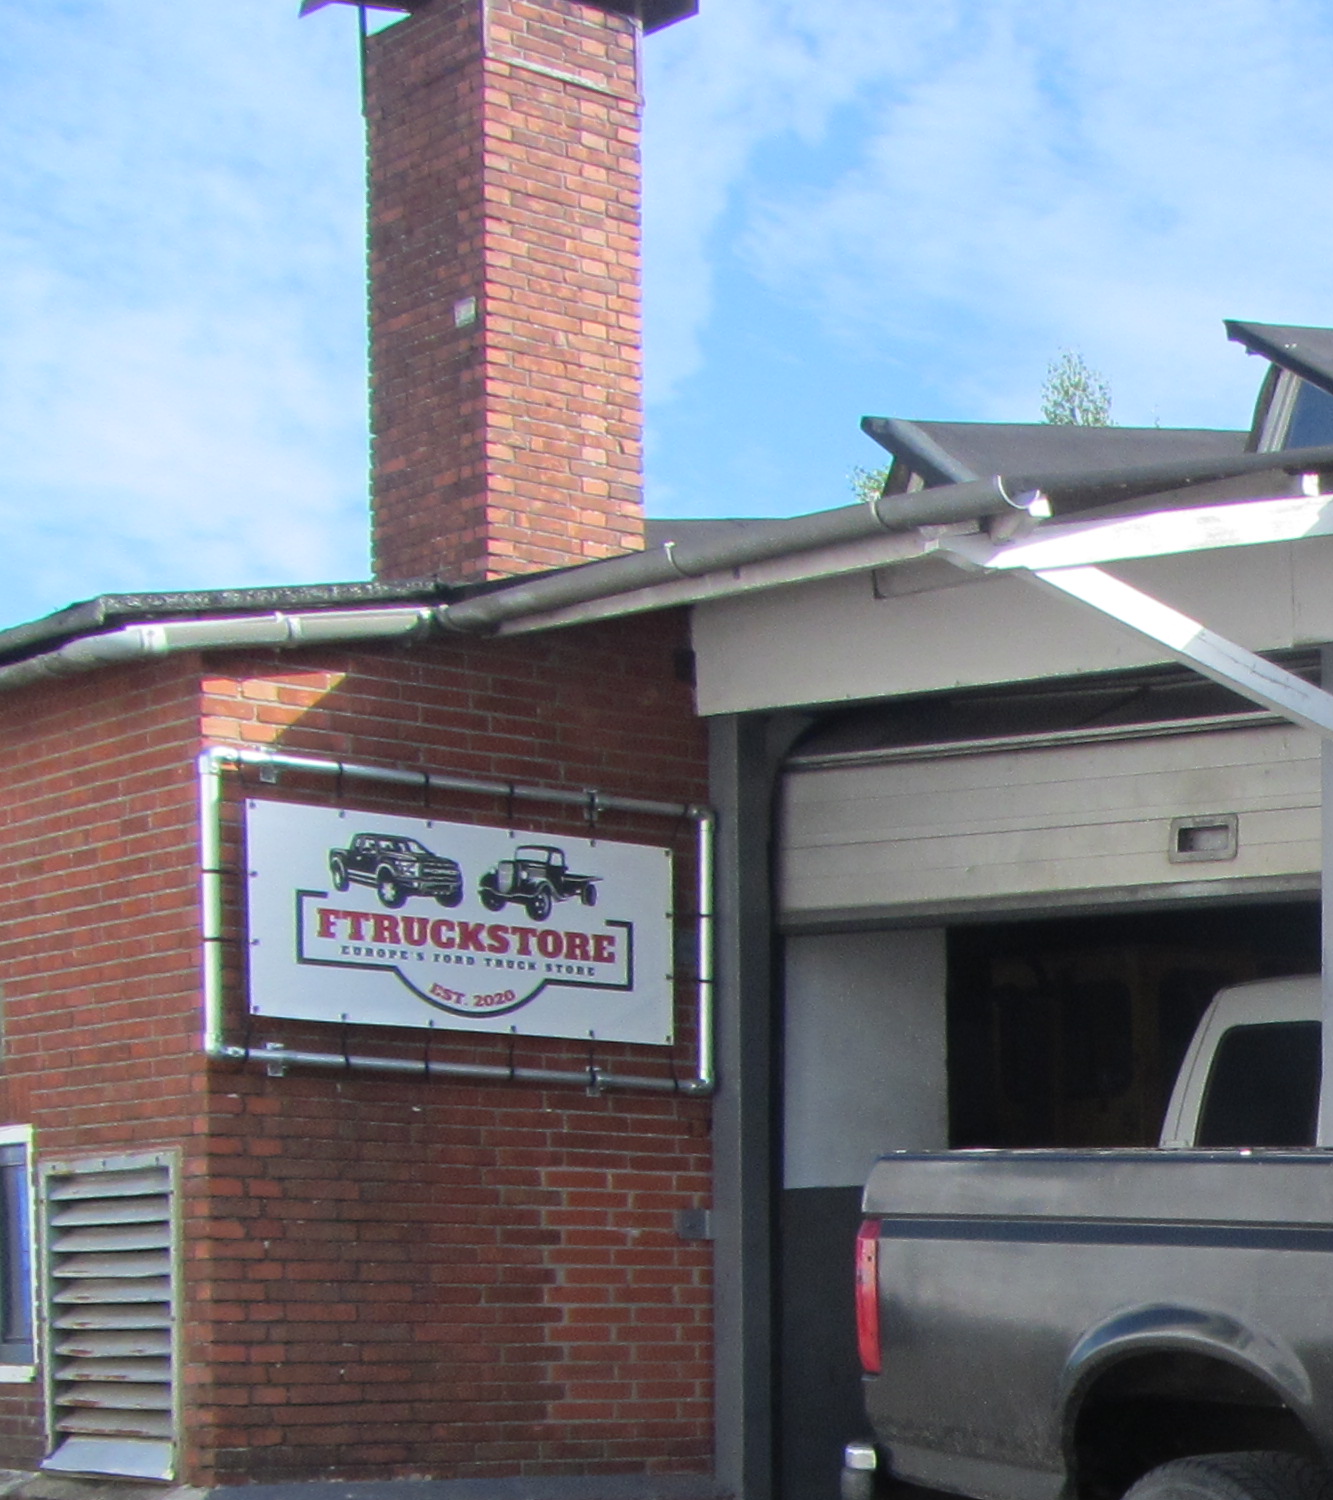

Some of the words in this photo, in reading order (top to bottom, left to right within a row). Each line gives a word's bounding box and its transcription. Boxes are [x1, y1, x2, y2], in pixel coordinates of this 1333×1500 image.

[316, 908, 616, 963] FTRUCKSTORE
[340, 945, 425, 961] EUROPE'S
[433, 953, 475, 966] FORD
[485, 959, 537, 971] TRUCK
[545, 963, 596, 976] STORE
[473, 989, 517, 1007] 2020
